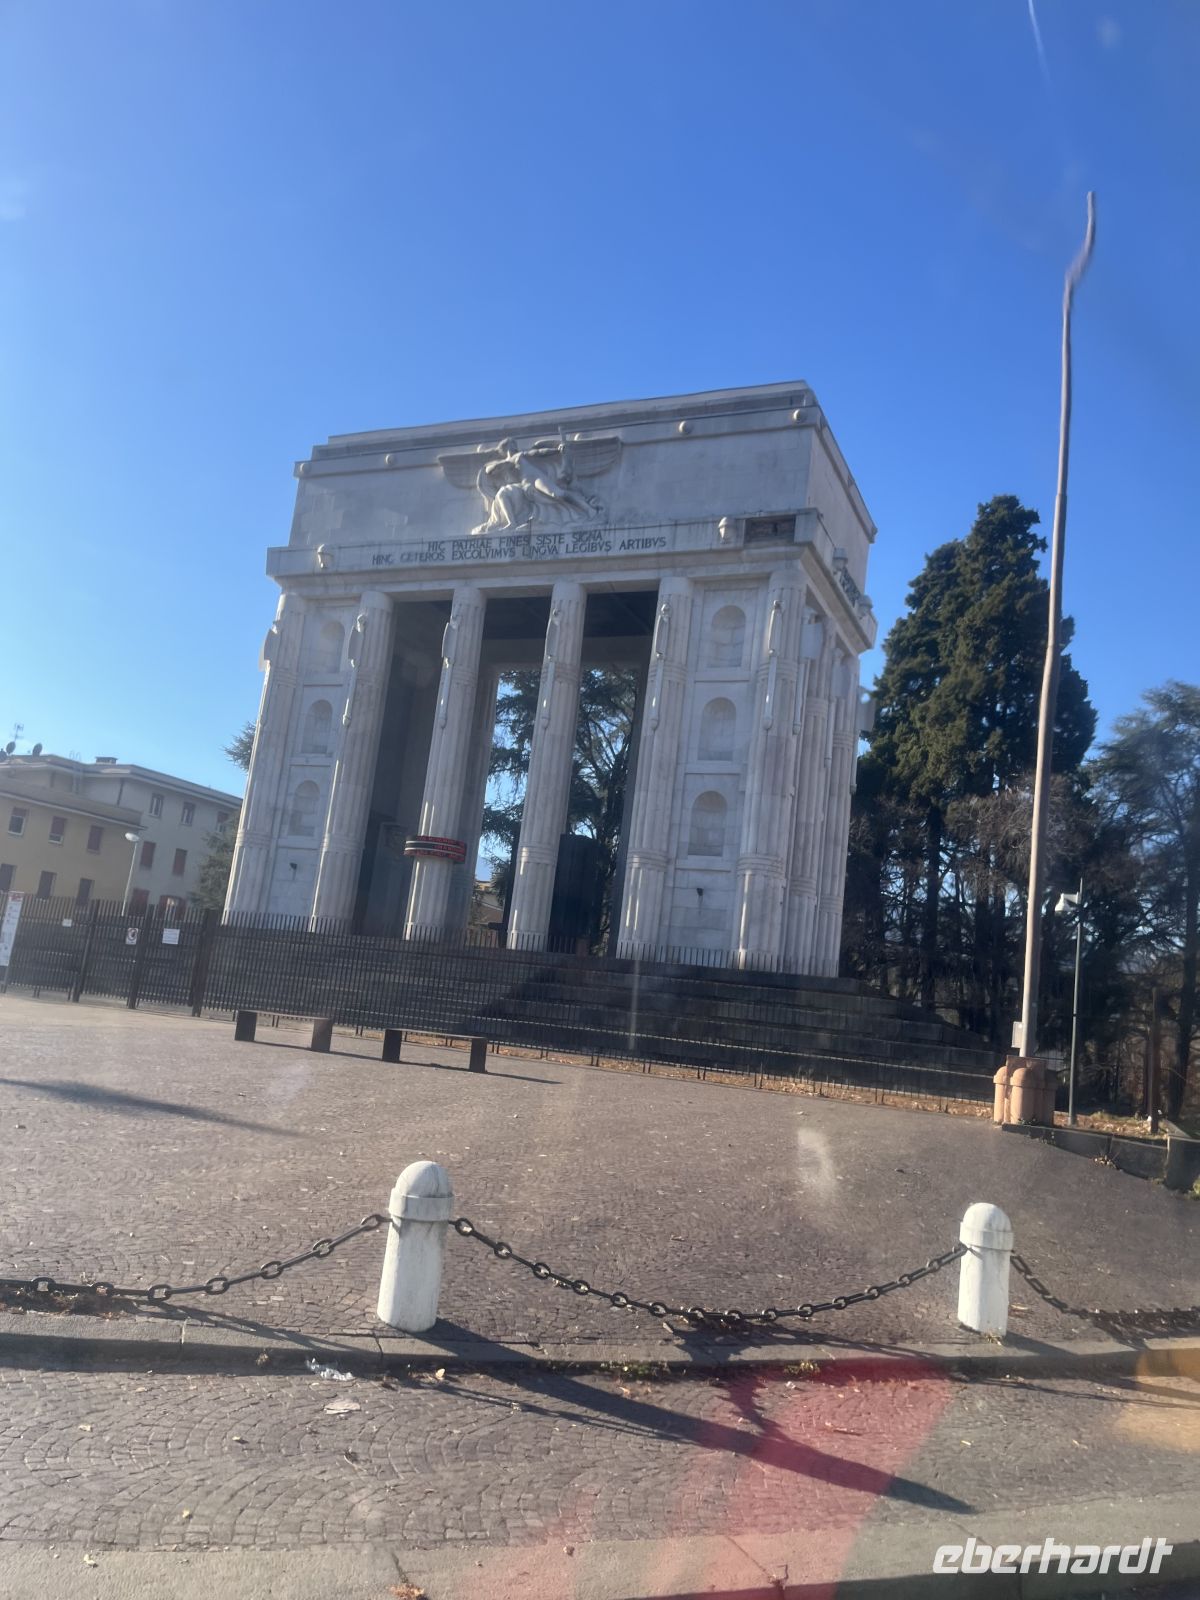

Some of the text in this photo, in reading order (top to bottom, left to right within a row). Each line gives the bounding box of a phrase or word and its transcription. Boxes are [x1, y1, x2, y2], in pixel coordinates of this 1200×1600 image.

[372, 537, 667, 565] HINC CETEROS EXCOLVIMVS LINGVA LEGIBVS ARTIBVS
[428, 530, 603, 551] HIC PATRIAE FINES SISTE SIGNA
